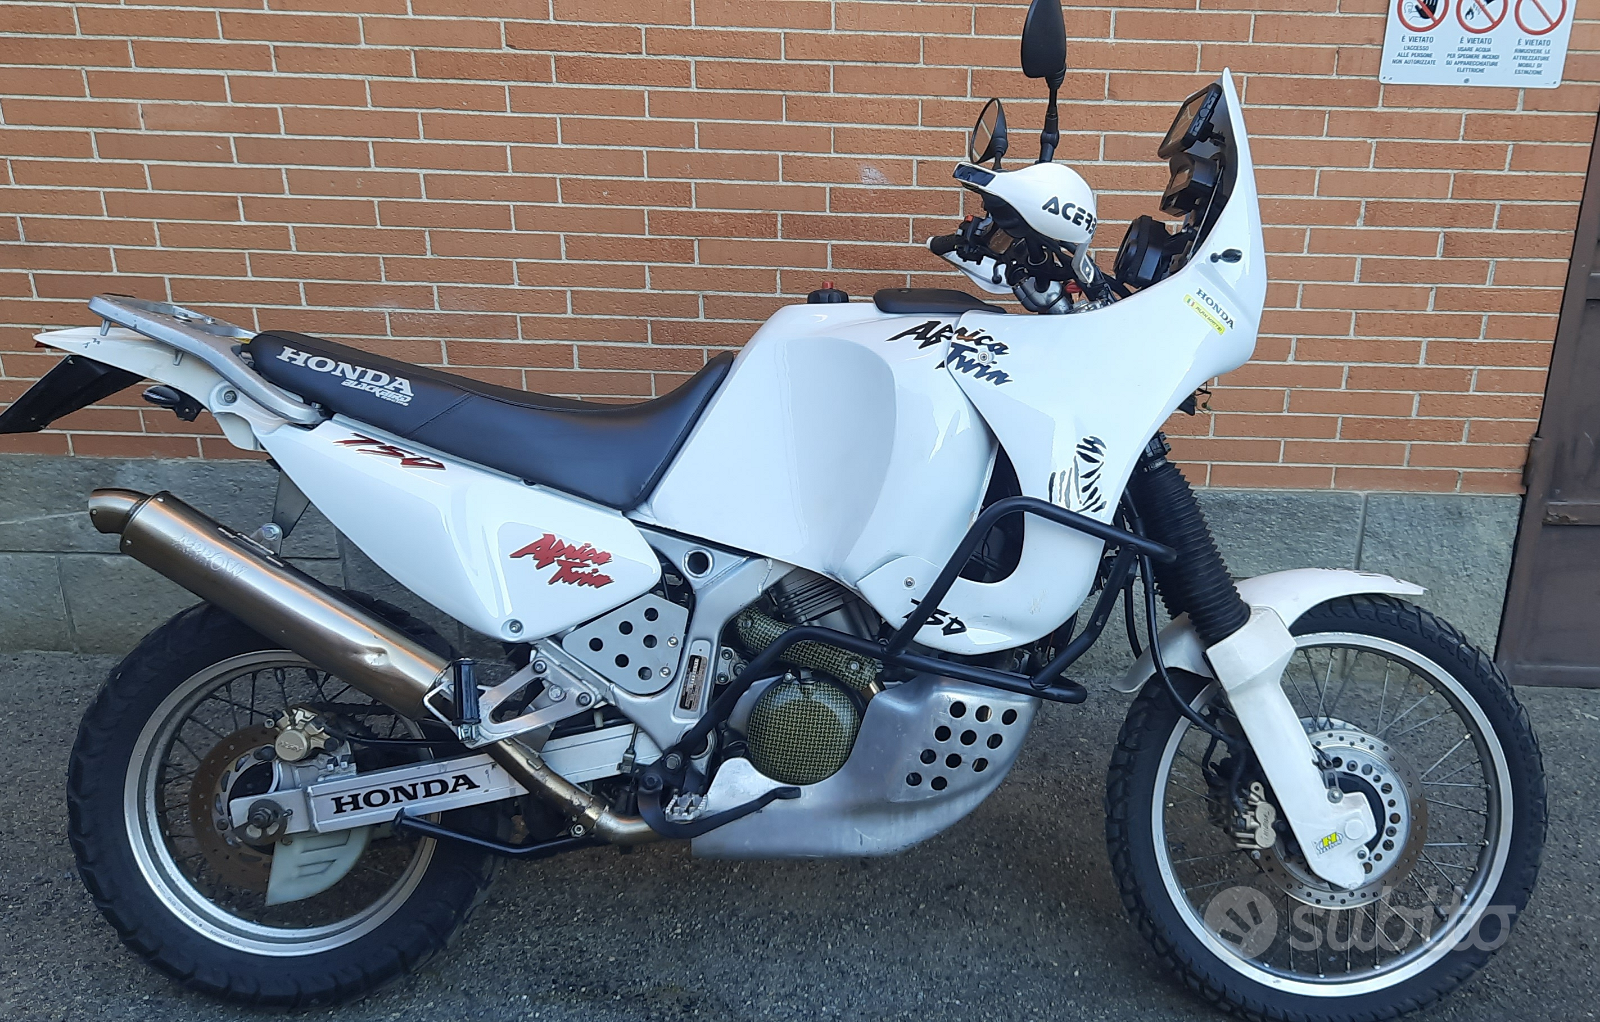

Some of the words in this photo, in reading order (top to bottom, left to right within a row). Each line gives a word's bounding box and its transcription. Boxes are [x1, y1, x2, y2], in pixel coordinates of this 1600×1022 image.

[1408, 35, 1434, 43] VIETATO
[1467, 37, 1493, 45] VIETATO
[1196, 287, 1234, 330] HONDA
[885, 320, 1010, 356] Africa
[276, 346, 415, 397] HONDA
[935, 341, 1013, 387] Twin
[340, 379, 413, 403] BLACKBIRD
[509, 532, 613, 570] Africa
[548, 558, 615, 589] Twin
[331, 773, 481, 815] HONDA
